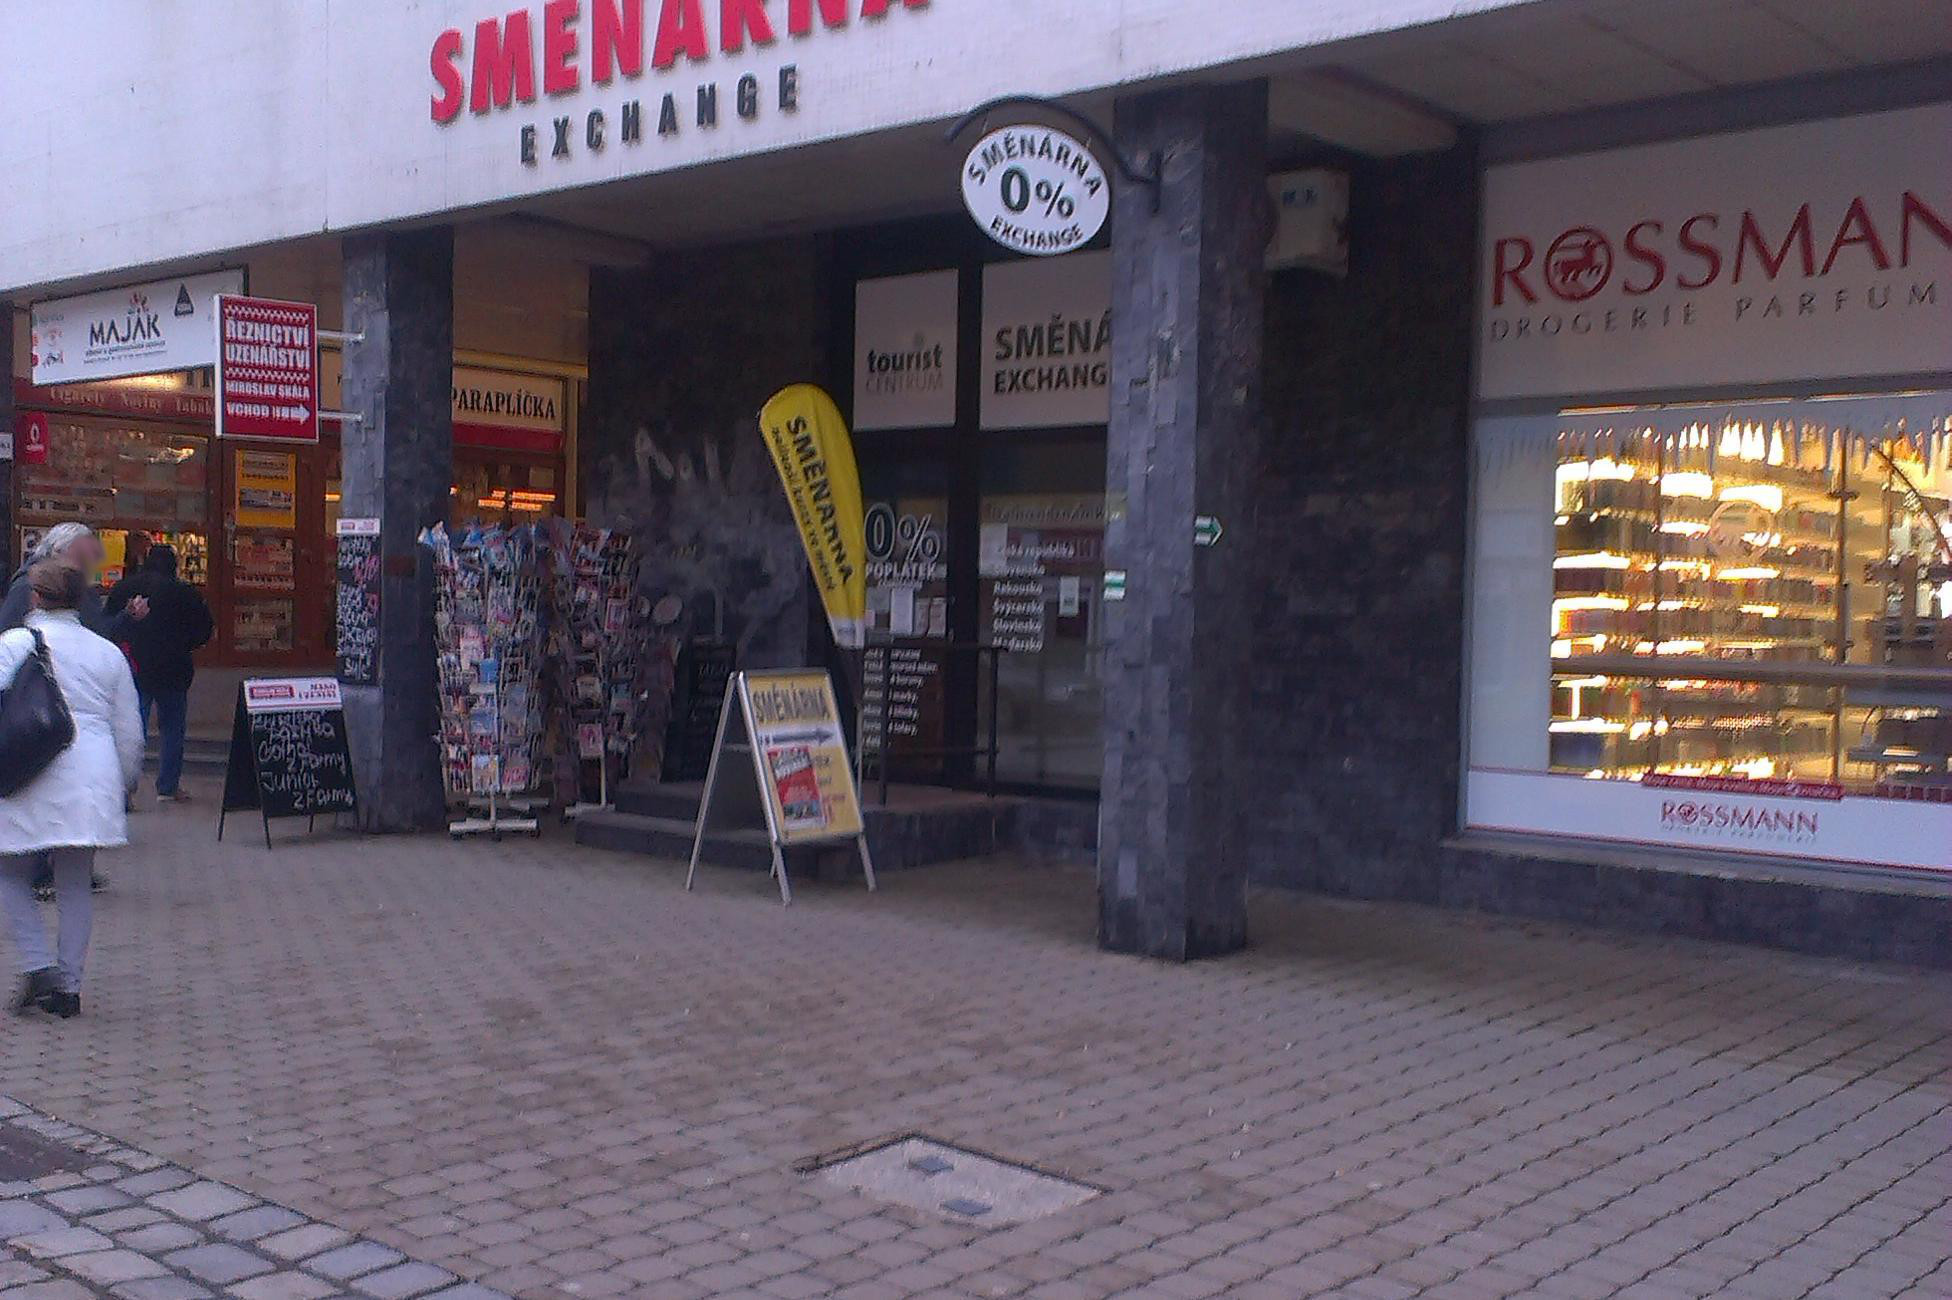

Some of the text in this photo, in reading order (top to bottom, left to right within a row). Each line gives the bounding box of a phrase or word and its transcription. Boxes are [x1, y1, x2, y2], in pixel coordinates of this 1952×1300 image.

[520, 63, 797, 164] EXCHANGE
[1001, 166, 1075, 219] 0%
[990, 214, 1084, 248] EXCHANGE
[1490, 281, 1937, 342] DROGERIE PARFUM
[867, 343, 943, 373] tourist
[866, 373, 943, 394] CENTRUM
[994, 363, 1107, 395] EXCHANG
[227, 401, 270, 418] VCHOD
[864, 502, 940, 562] 0%
[1660, 800, 1819, 836] ROSSMANN
